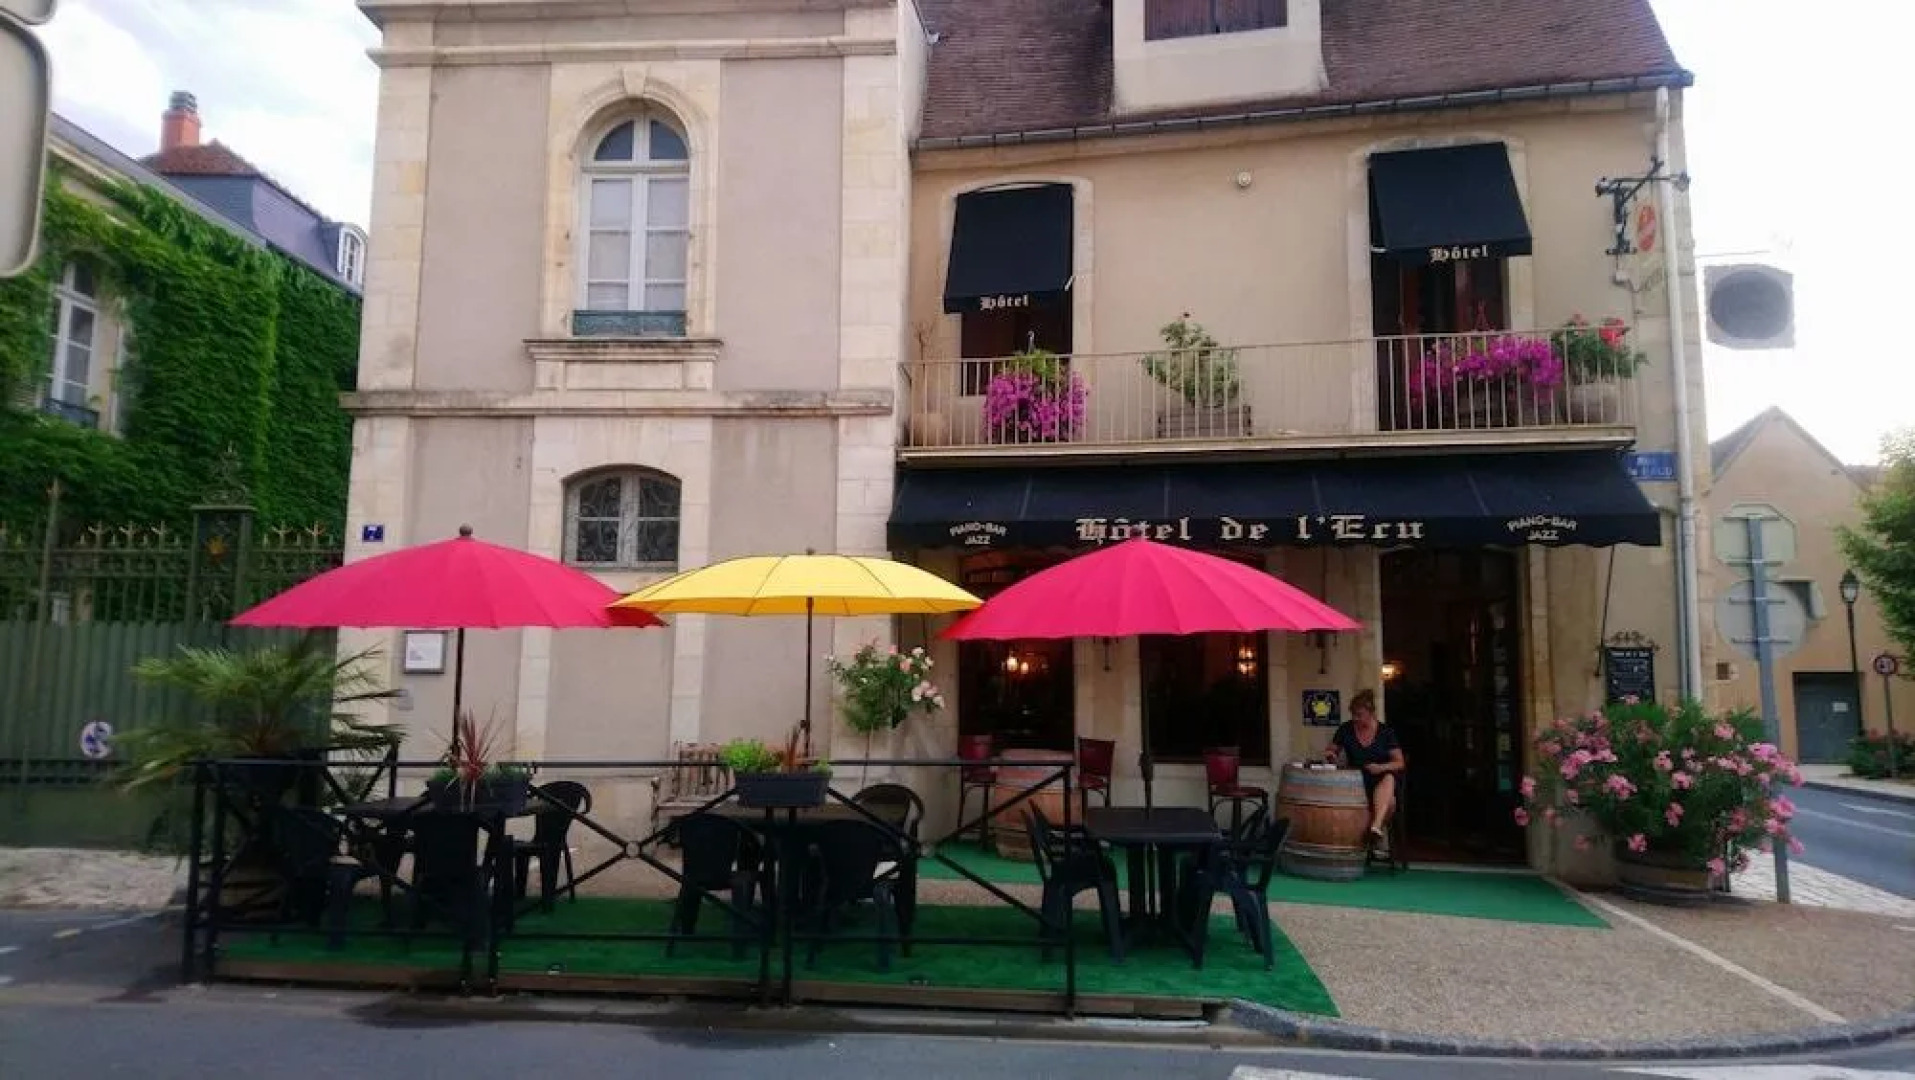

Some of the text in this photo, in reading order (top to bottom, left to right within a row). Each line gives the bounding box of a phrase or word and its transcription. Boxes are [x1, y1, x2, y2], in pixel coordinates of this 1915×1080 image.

[1429, 244, 1489, 263] Hôtel
[979, 294, 1029, 312] Hôtel
[1075, 514, 1425, 545] Hôtel de l'Ecu
[1526, 530, 1560, 541] JAZZ
[964, 535, 991, 545] JAZZ
